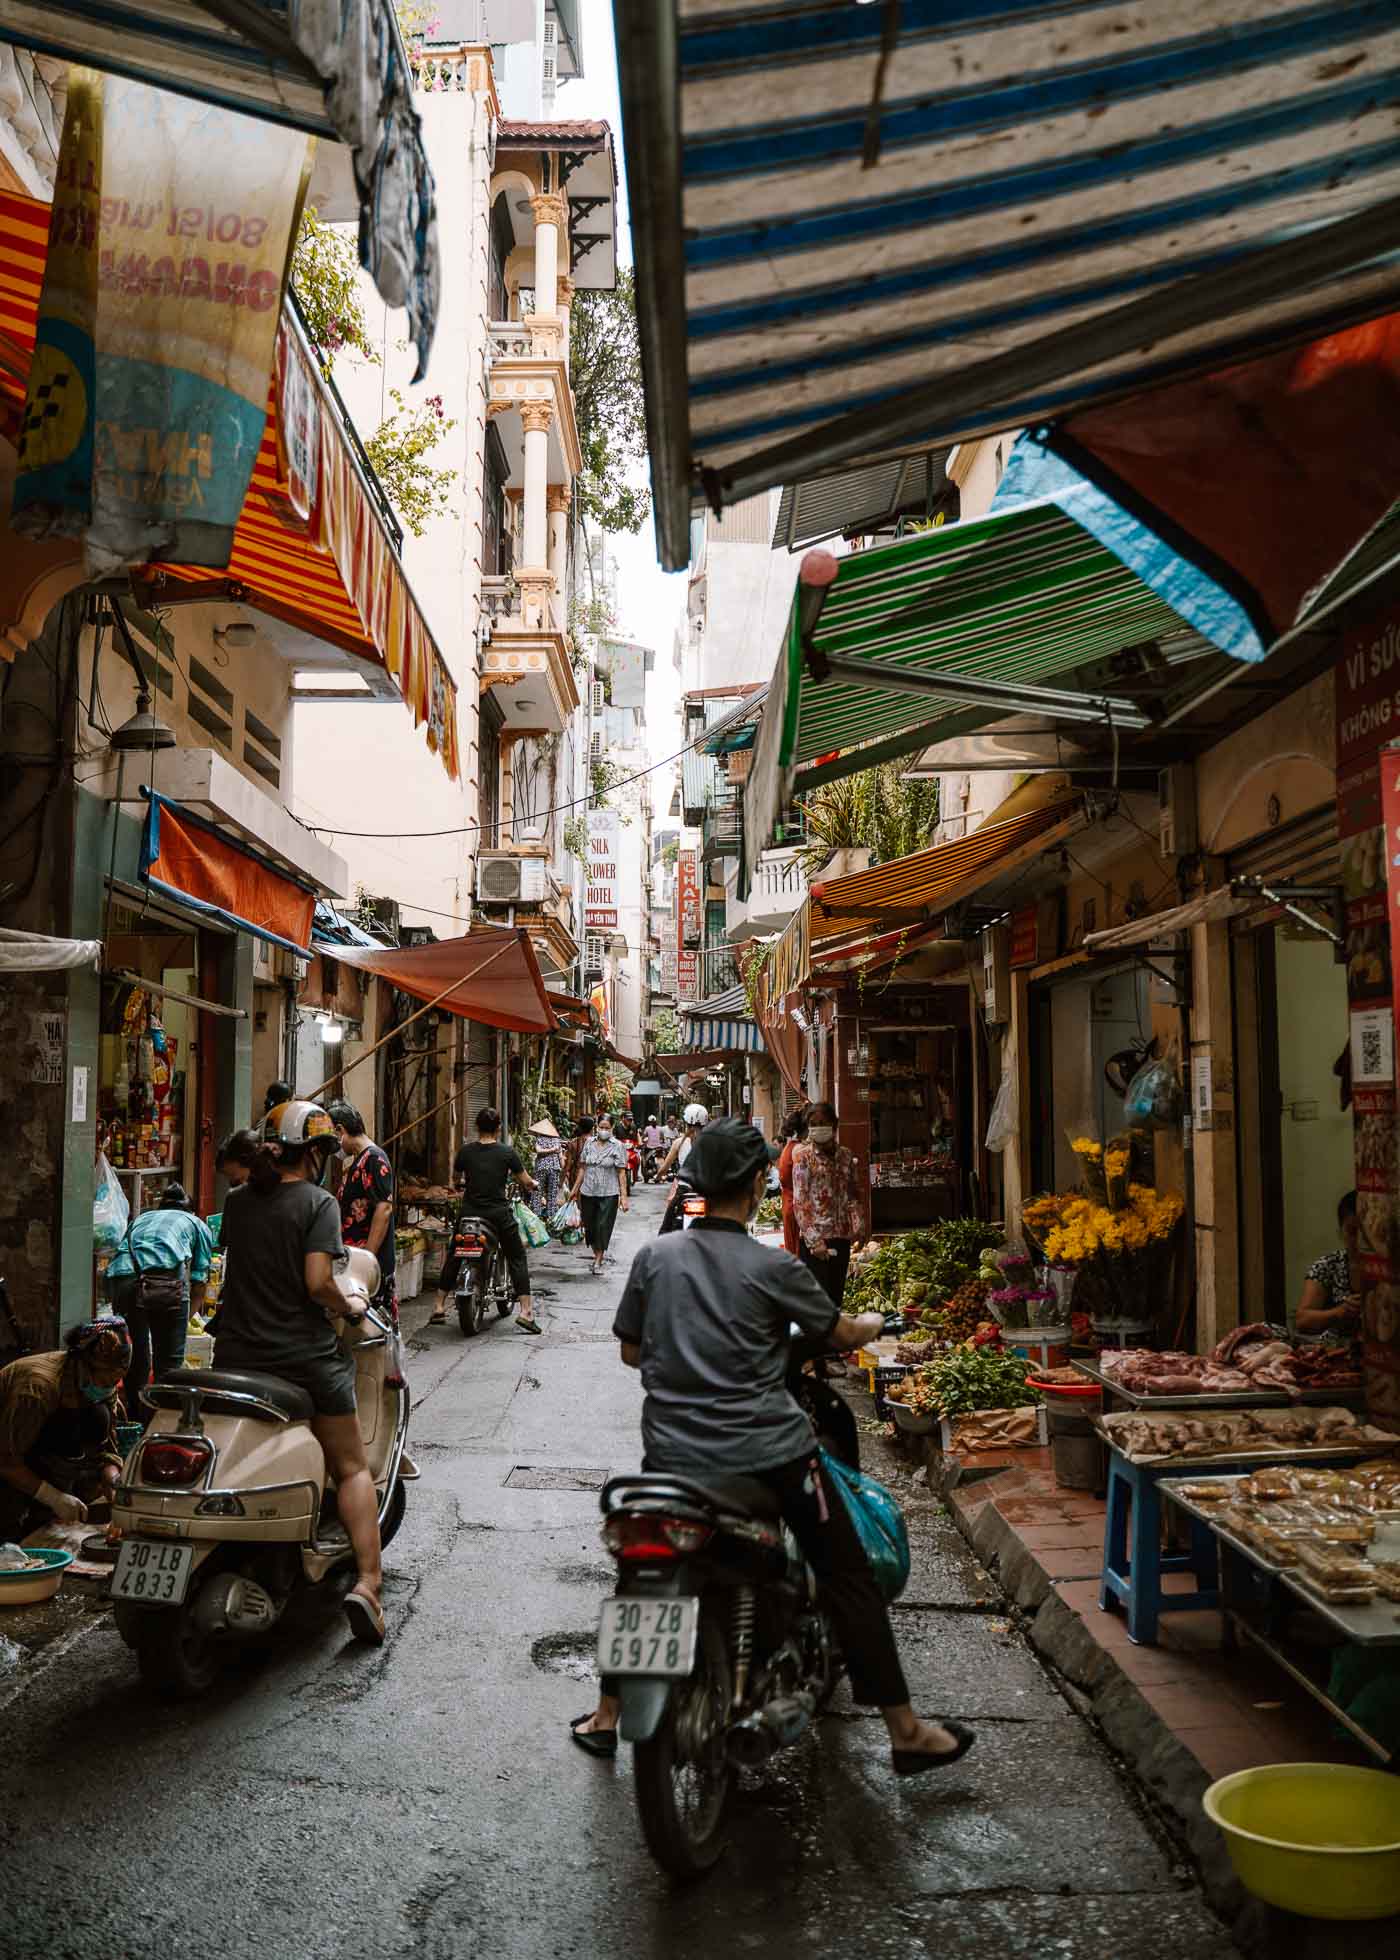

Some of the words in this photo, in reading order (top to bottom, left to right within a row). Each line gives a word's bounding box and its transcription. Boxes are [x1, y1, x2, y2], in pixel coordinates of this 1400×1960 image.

[591, 838, 609, 854] SILK
[588, 863, 616, 880] OWER
[587, 887, 613, 904] HOTEL
[127, 1543, 183, 1571] 30-L8
[120, 1570, 176, 1599] 4833
[613, 1602, 683, 1634] 30-Z8
[609, 1637, 680, 1668] 6978
